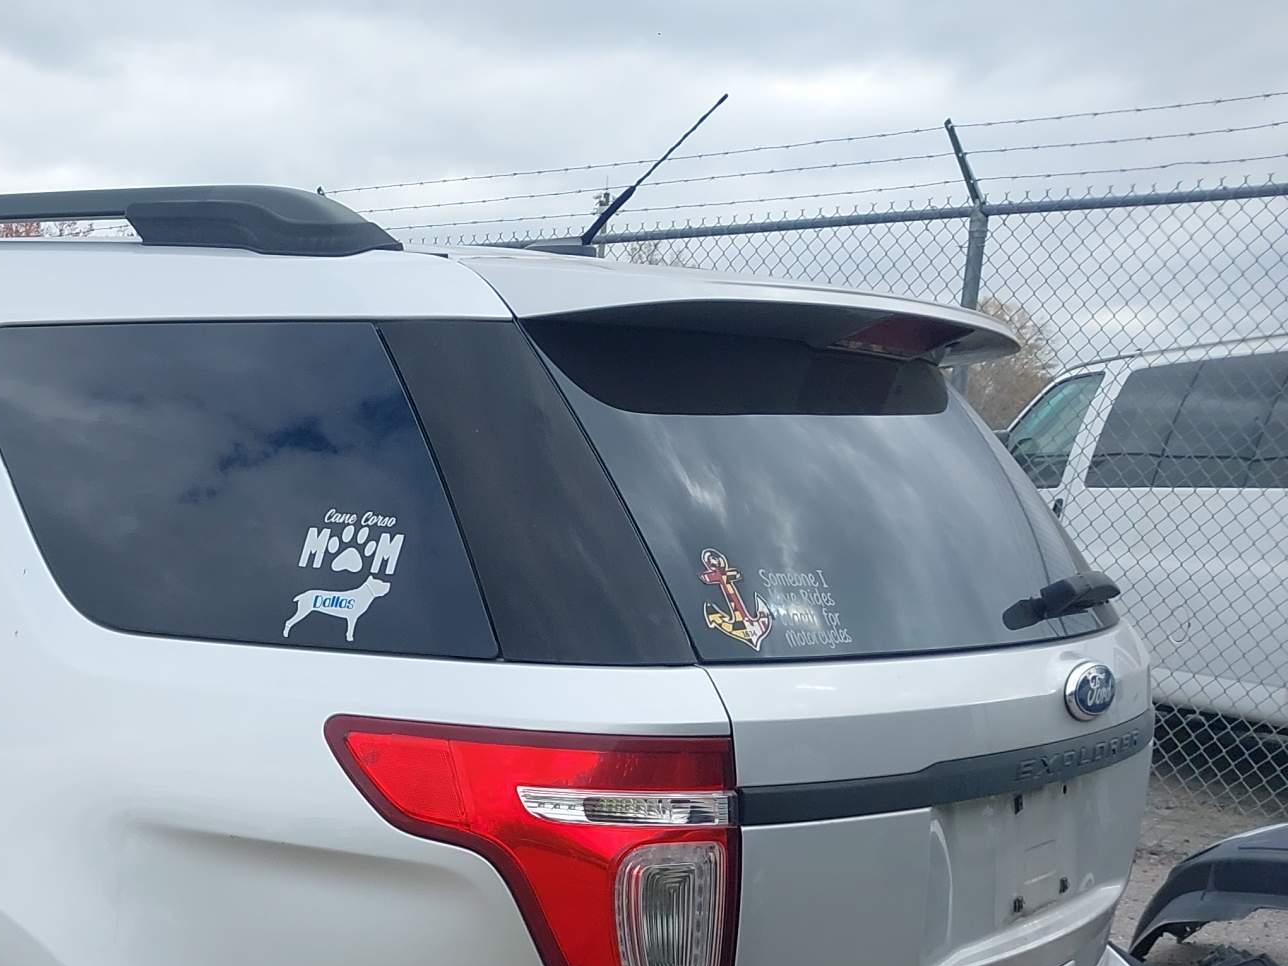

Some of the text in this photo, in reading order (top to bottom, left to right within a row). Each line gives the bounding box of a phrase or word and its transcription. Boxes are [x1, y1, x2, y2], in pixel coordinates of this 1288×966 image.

[324, 508, 397, 527] Cane Corso
[758, 568, 829, 588] Someone I
[312, 595, 355, 609] Dallas
[767, 587, 836, 608] Lve Rides
[822, 607, 841, 627] for
[785, 625, 853, 649] Motorcycles
[1087, 672, 1112, 706] Ford
[1016, 729, 1142, 781] EXPLORER
